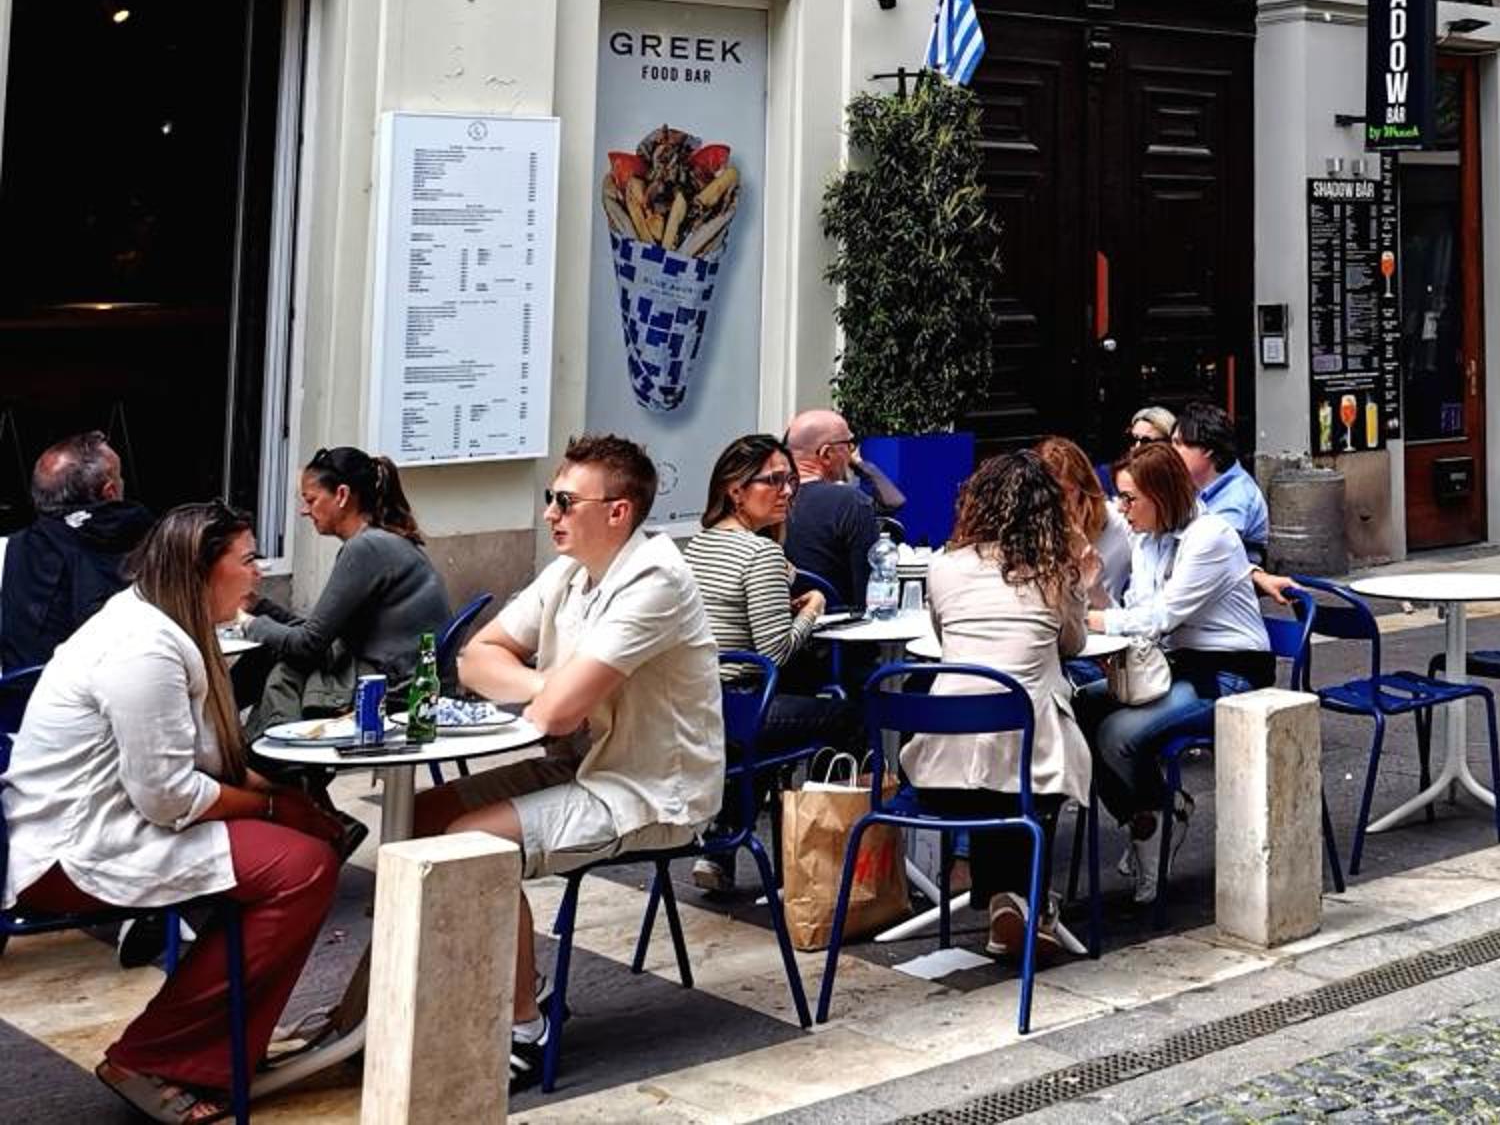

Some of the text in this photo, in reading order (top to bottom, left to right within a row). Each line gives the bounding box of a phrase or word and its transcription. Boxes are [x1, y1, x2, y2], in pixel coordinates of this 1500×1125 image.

[609, 31, 743, 64] GREEK
[641, 65, 712, 84] FOOD BAR
[1312, 180, 1354, 198] SHADOW
